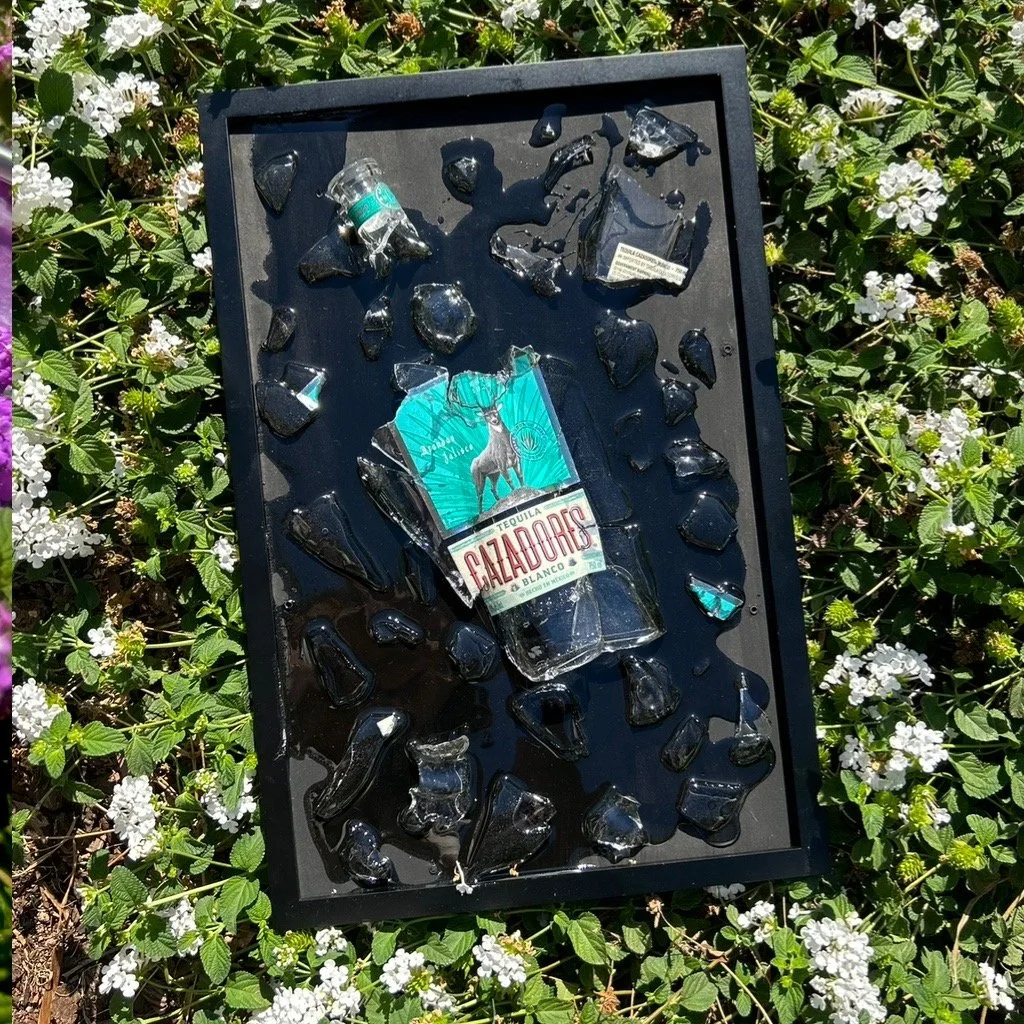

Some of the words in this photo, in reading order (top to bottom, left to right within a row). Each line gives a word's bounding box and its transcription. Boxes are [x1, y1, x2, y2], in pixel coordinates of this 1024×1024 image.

[496, 508, 542, 532] TEQUILA
[464, 506, 592, 592] CAZADORES
[522, 562, 565, 586] BLANCO
